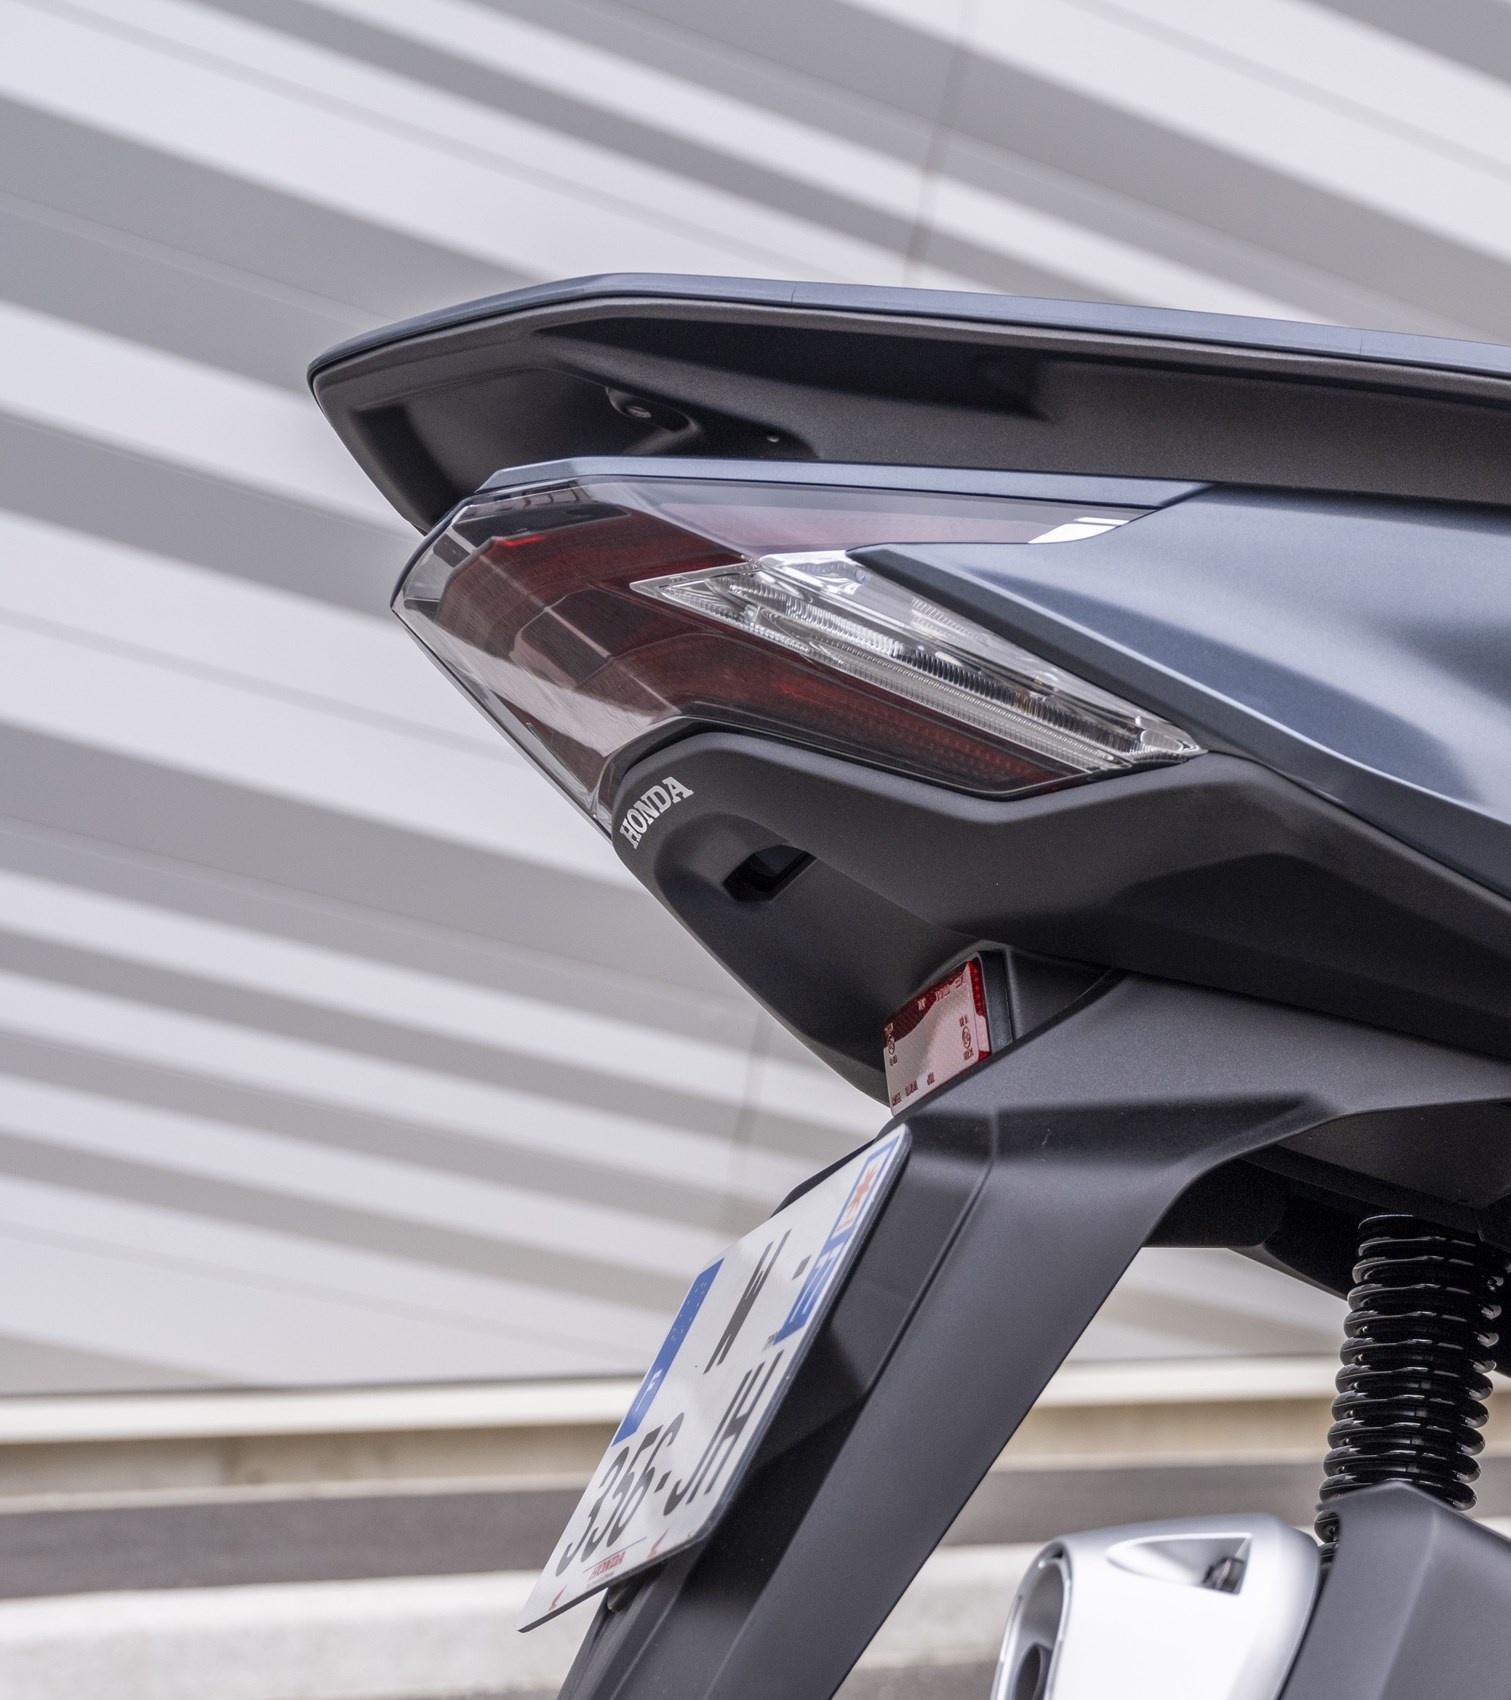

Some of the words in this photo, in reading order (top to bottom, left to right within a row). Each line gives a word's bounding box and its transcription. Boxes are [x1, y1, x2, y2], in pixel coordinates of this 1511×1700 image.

[619, 776, 694, 850] HONDA
[703, 1228, 792, 1376] W
[788, 1241, 844, 1324] 77
[635, 1369, 663, 1412] F
[555, 1349, 784, 1577] 356-JH
[588, 1550, 627, 1581] HONDA
